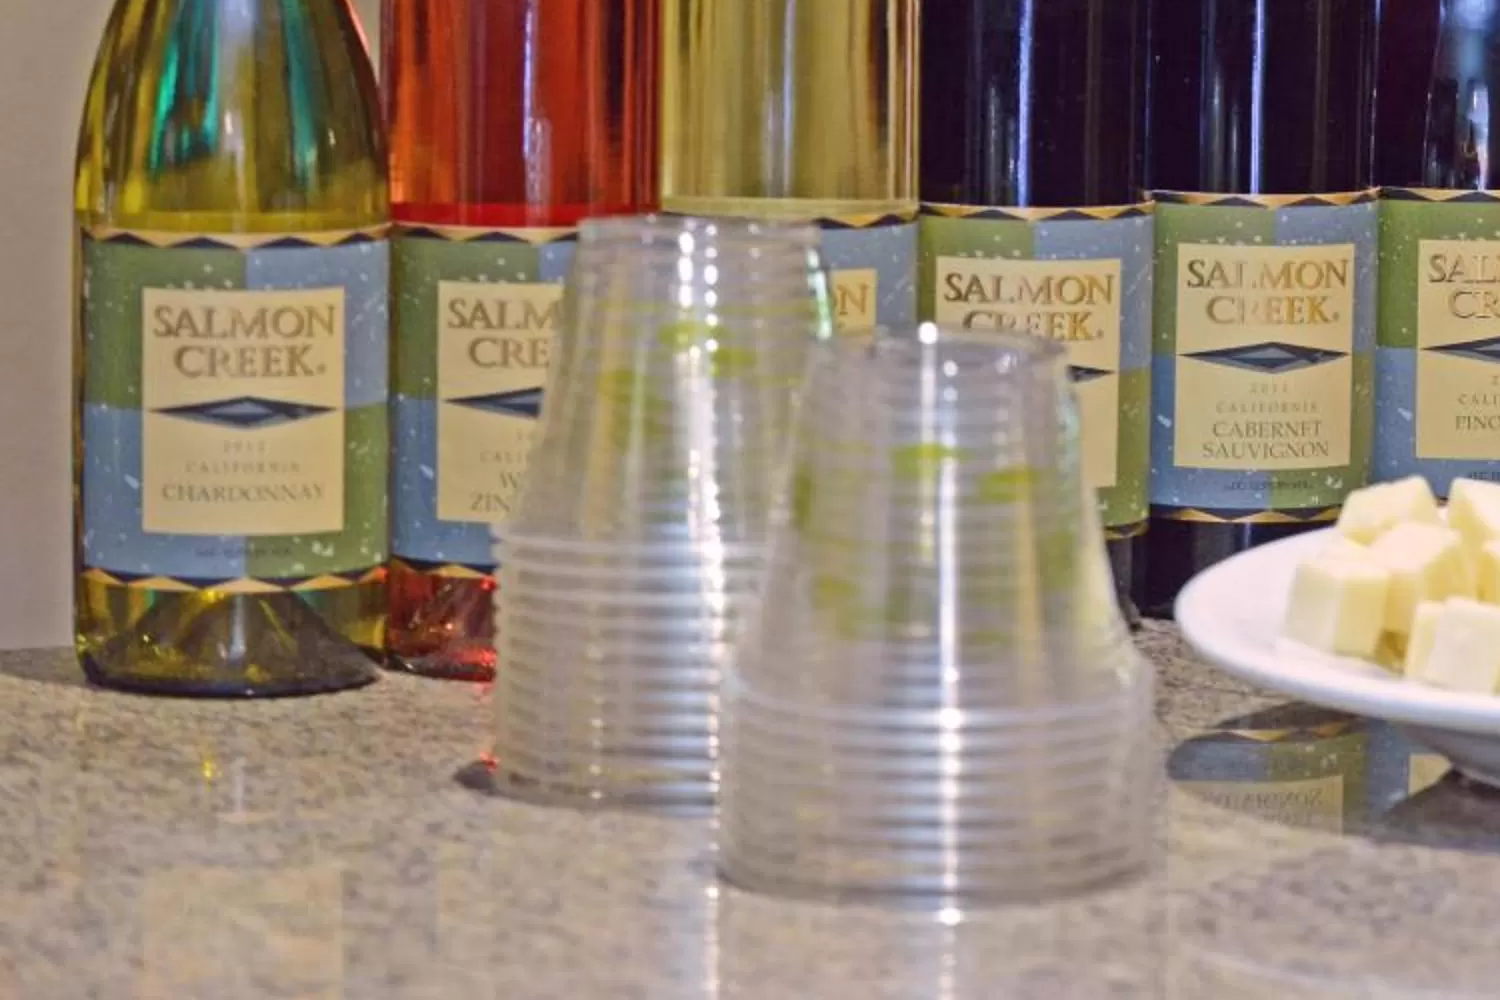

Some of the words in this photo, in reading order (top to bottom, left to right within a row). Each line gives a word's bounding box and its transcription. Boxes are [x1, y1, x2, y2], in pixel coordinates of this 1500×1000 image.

[943, 271, 1115, 306] SALMON
[1186, 258, 1350, 290] SALMON
[153, 304, 336, 340] SALMON
[447, 297, 562, 331] SALM
[467, 336, 550, 370] CRE
[1211, 419, 1323, 439] CABERNET
[1202, 439, 1329, 460] SAUVIGNON
[161, 481, 325, 503] CHARDONNAY
